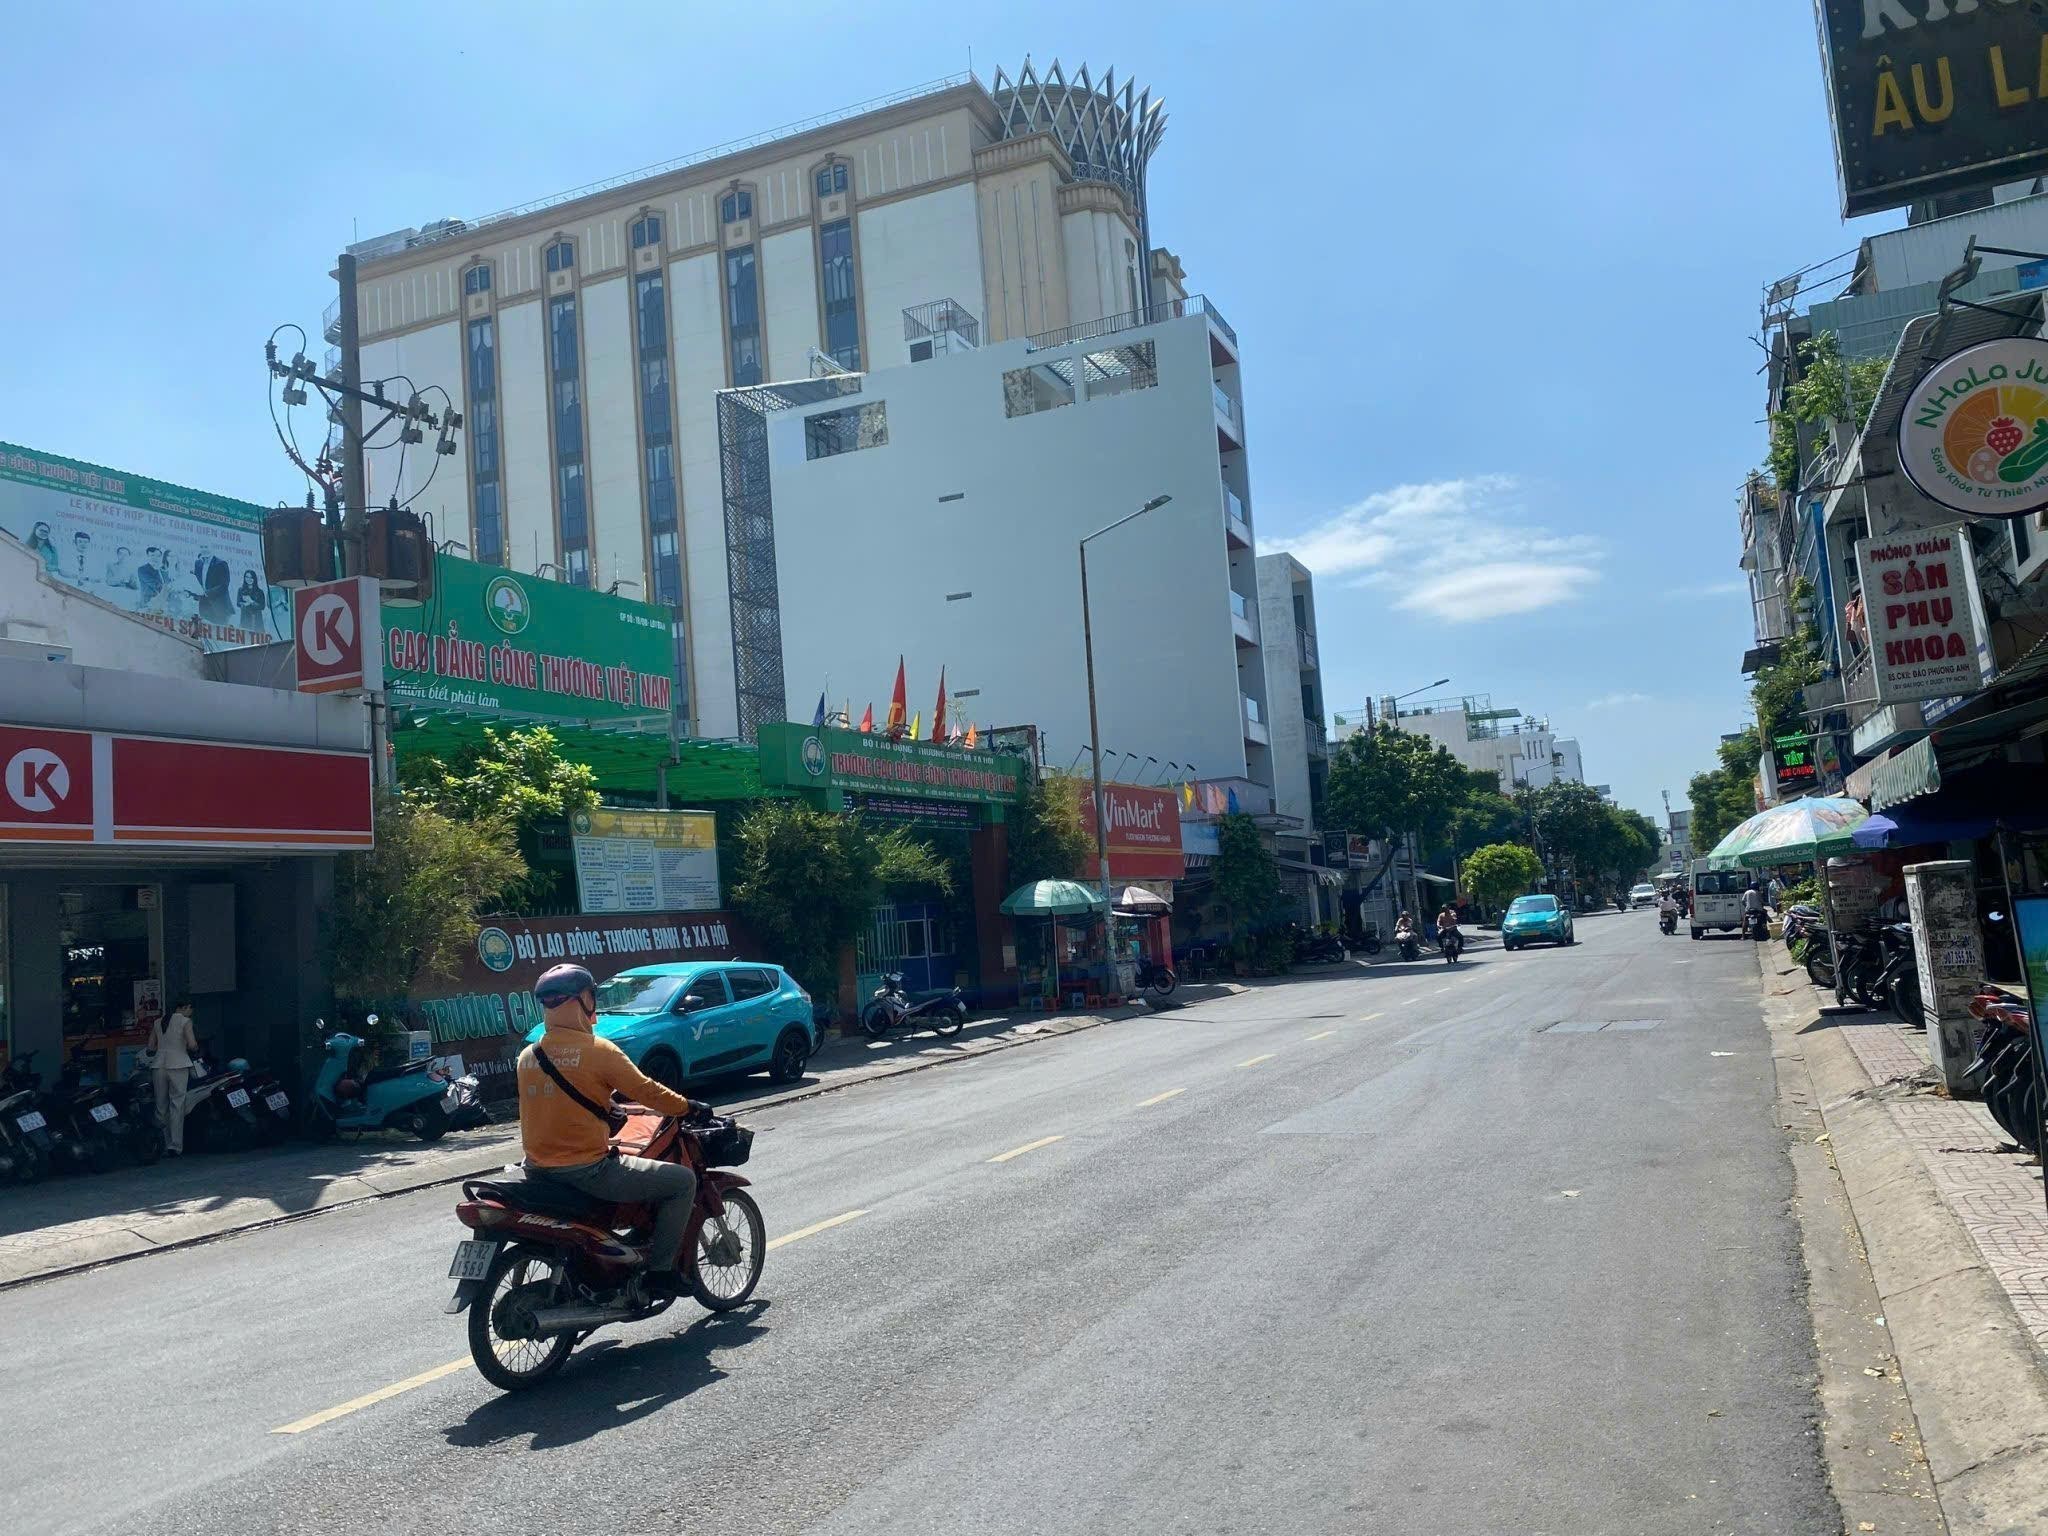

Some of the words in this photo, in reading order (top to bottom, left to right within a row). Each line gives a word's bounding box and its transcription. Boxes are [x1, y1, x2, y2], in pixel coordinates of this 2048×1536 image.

[1871, 54, 1955, 137] ÂU
[1989, 33, 2048, 108] L
[1870, 544, 1912, 562] PHÒNG
[1915, 536, 1952, 555] KHÁM
[1882, 560, 1949, 596] SẢN
[314, 606, 352, 654] K
[1885, 597, 1954, 630] PHỤ
[389, 627, 430, 674] CAO
[433, 620, 487, 682] ĐẲNG
[489, 639, 537, 690] CÔNG
[540, 654, 605, 700] THƯƠNG
[605, 661, 637, 711] VIỆT
[639, 672, 672, 711] NAM
[1884, 632, 1967, 666] KHOA
[23, 761, 64, 807] K
[515, 928, 537, 963] BỘ
[538, 931, 564, 958] LAO
[652, 925, 680, 949] BINH
[682, 925, 692, 947] &
[710, 919, 730, 950] HỘI
[508, 990, 545, 1034] CA
